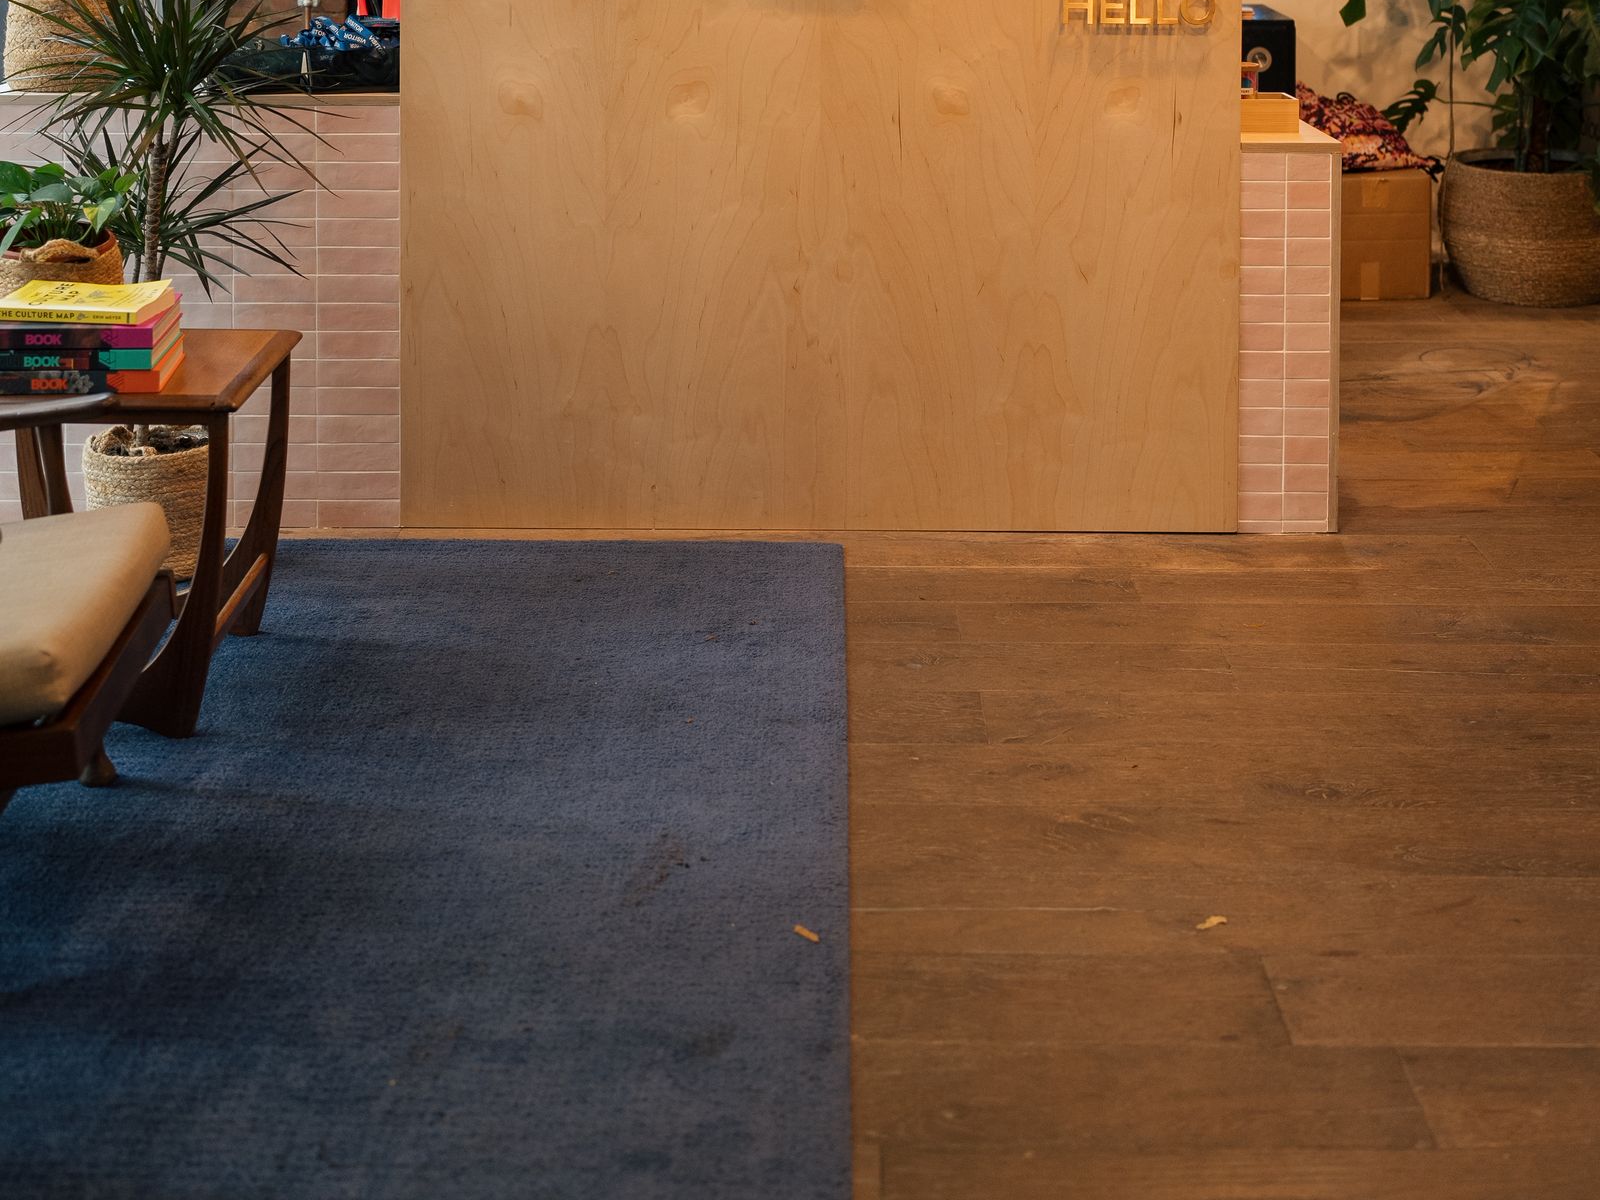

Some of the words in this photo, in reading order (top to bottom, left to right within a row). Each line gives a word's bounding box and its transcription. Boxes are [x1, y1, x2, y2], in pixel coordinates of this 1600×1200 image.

[347, 18, 364, 33] VISITOR
[343, 32, 367, 45] VISITOR
[15, 310, 53, 319] CULTURE
[25, 334, 62, 345] BOOK
[23, 356, 60, 367] BOOK
[31, 378, 68, 390] BOOK
